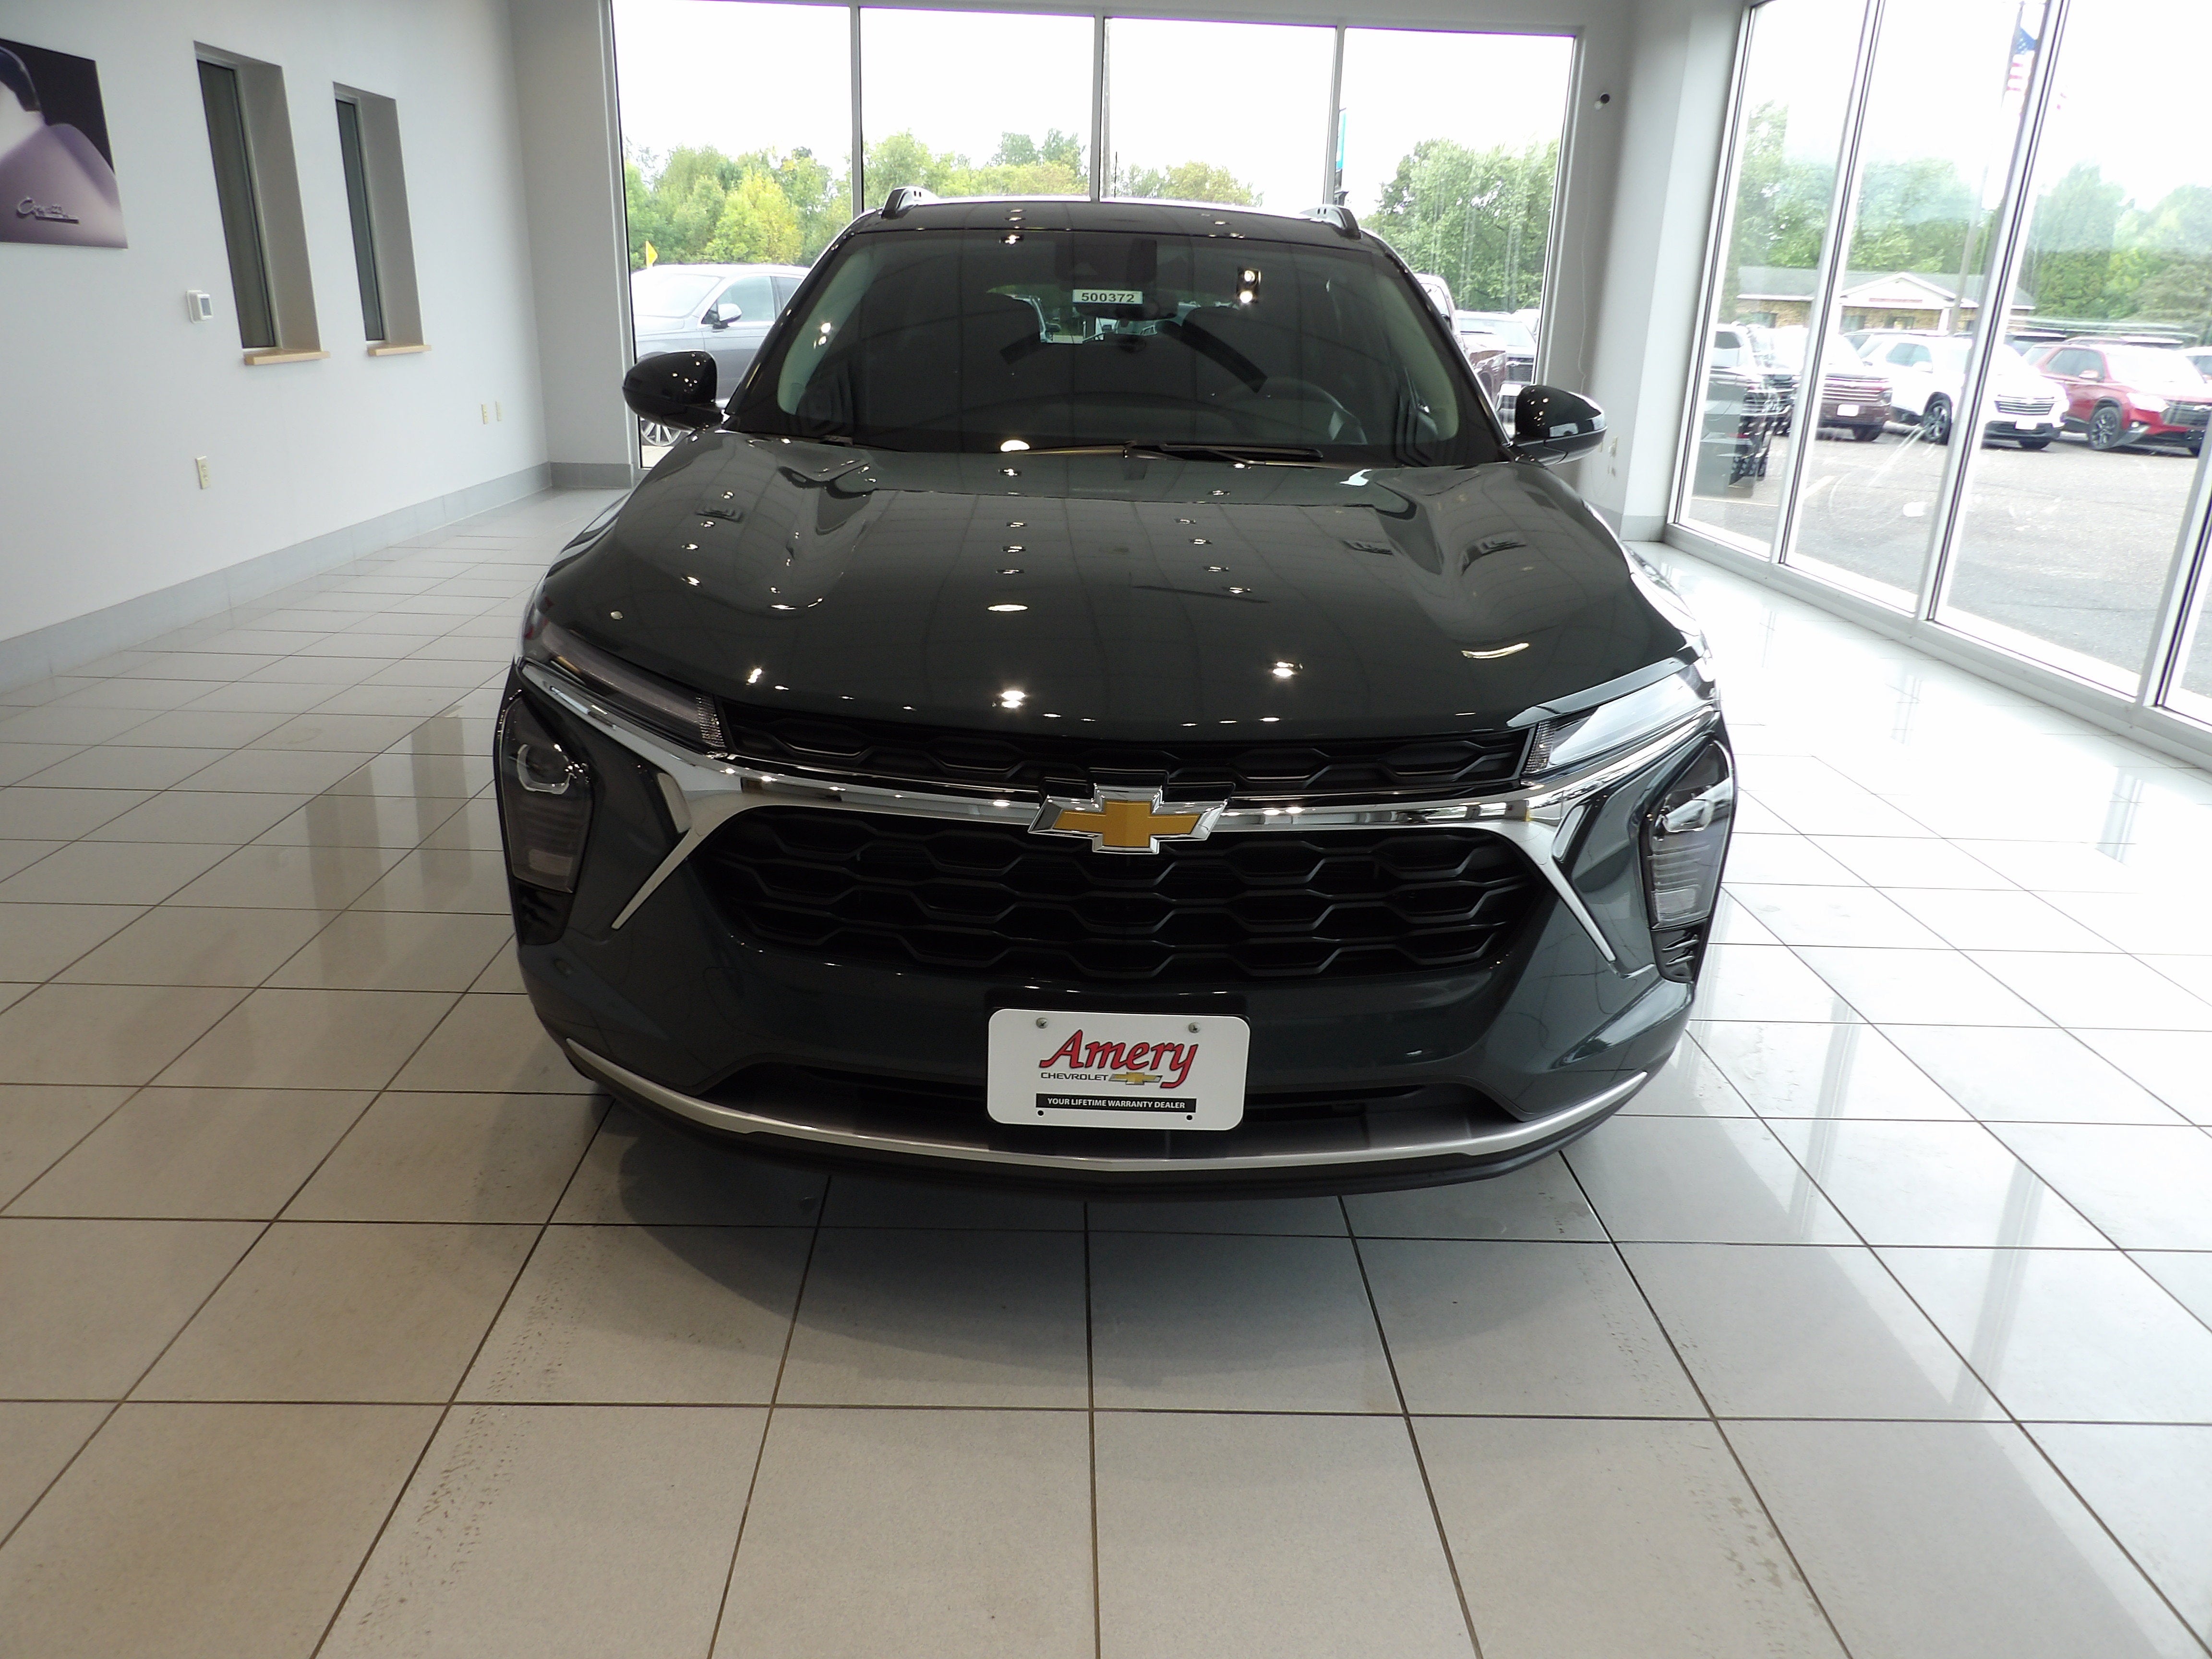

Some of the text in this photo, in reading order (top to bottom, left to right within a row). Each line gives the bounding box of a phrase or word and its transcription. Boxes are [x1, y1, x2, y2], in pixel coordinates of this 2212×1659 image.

[1082, 293, 1134, 302] 500372
[1039, 1029, 1199, 1088] Amery
[1041, 1072, 1108, 1081] CHEVROLET
